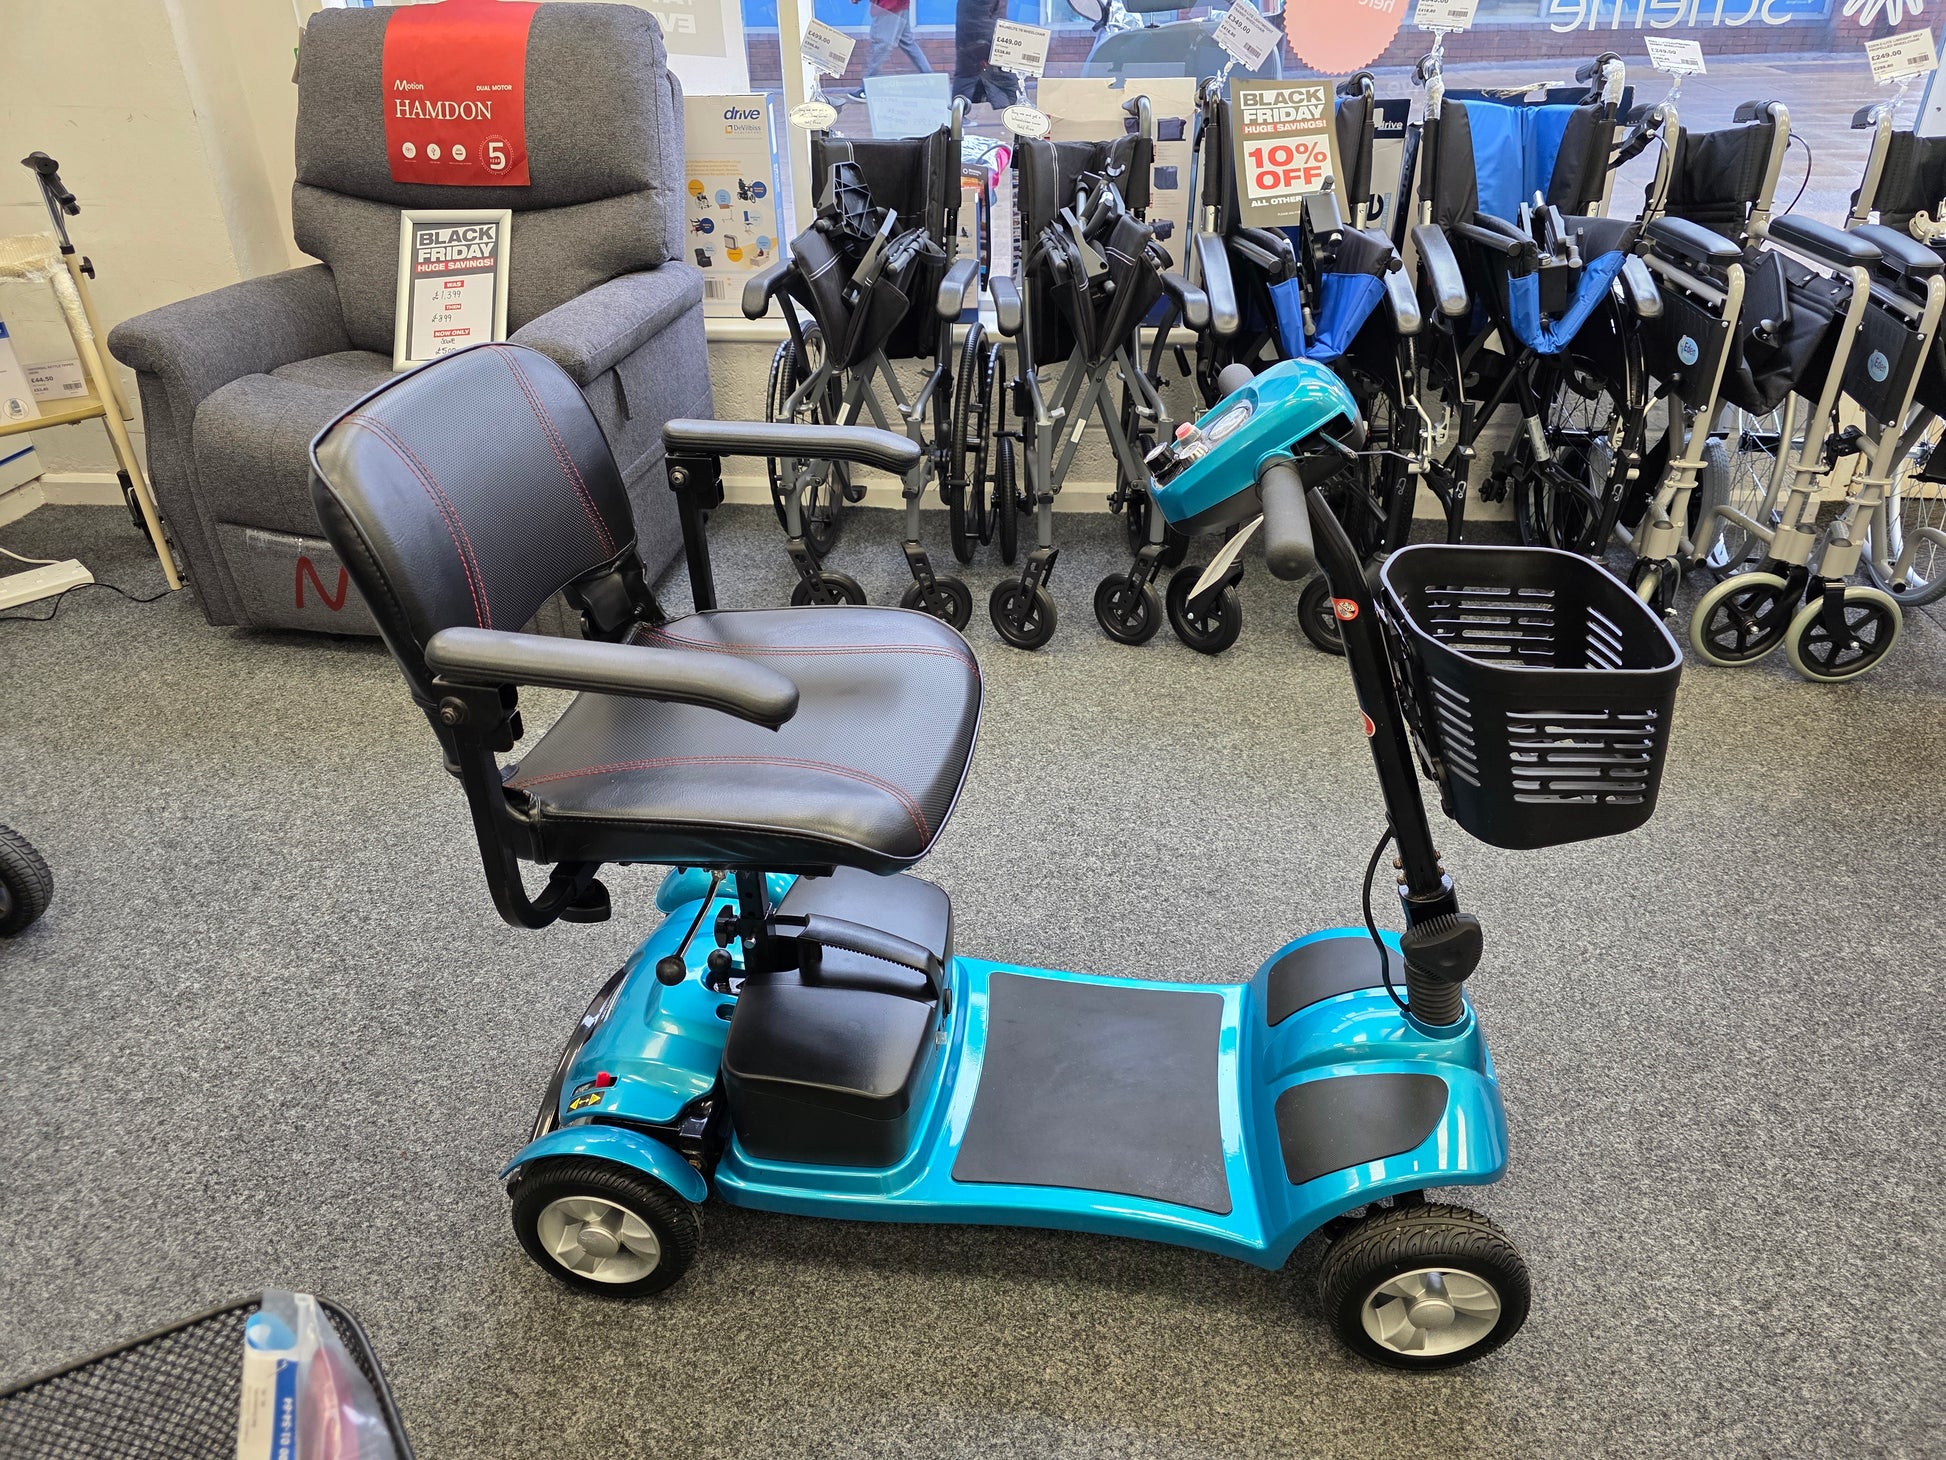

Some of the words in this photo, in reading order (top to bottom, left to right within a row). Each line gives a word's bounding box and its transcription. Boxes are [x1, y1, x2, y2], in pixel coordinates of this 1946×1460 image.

[1228, 14, 1251, 34] £349.00
[997, 37, 1022, 46] £449.00
[1871, 49, 1902, 61] £249.00
[393, 79, 424, 92] Motion
[1242, 88, 1324, 107] BLACK
[395, 99, 492, 121] HAMDON
[724, 106, 760, 120] drive
[1243, 105, 1324, 124] FRIDAY
[1244, 125, 1275, 134] HUGE
[1276, 120, 1327, 132] SAVINGS!
[488, 142, 506, 170] 5
[1248, 141, 1328, 169] 10%
[1255, 165, 1323, 191] OFF
[1251, 199, 1269, 208] ALL
[1271, 195, 1303, 205] OTHER
[419, 227, 494, 247] BLACK
[418, 242, 495, 263] FRIDAY
[418, 262, 446, 272] HUGE
[447, 258, 494, 270] SAVINGS!
[31, 376, 54, 384] £44.50
